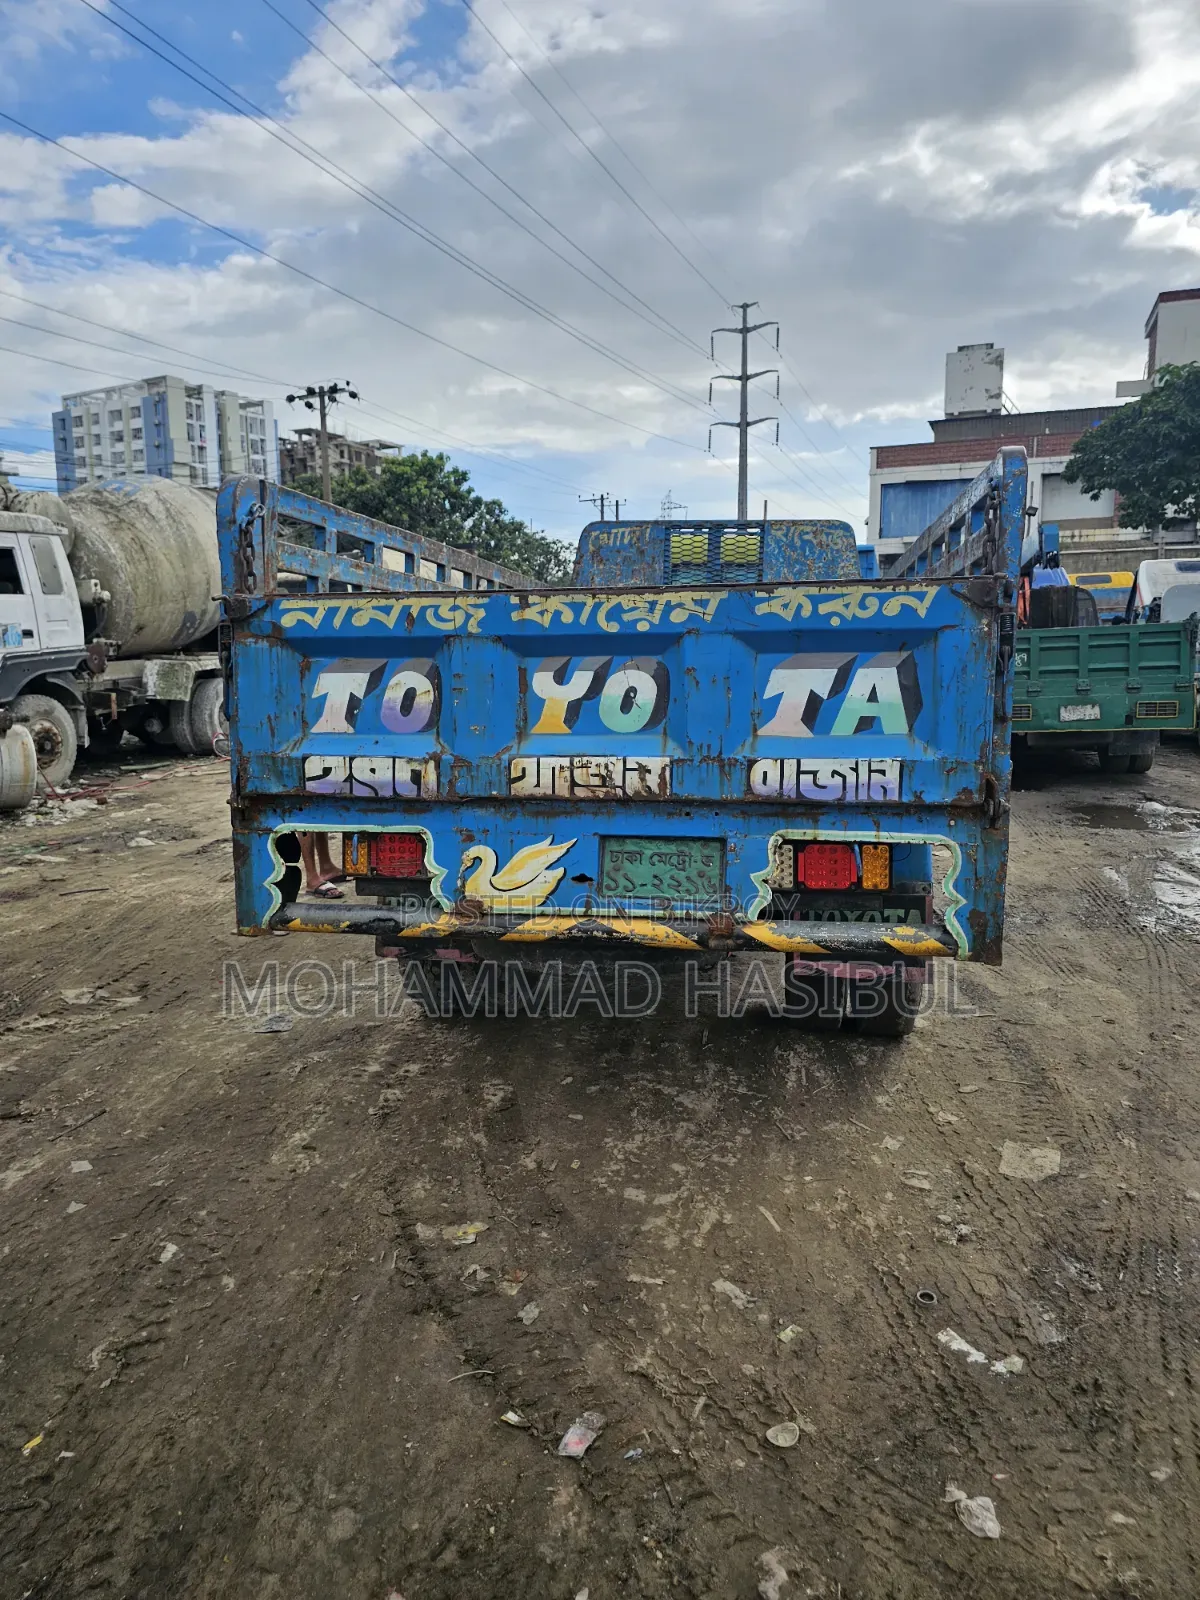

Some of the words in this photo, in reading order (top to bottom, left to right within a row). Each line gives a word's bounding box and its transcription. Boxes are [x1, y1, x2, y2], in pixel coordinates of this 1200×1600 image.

[279, 597, 489, 633] নামাজ
[511, 591, 728, 632] কায়েম
[755, 585, 940, 626] করুন
[609, 849, 645, 866] ঢাকা
